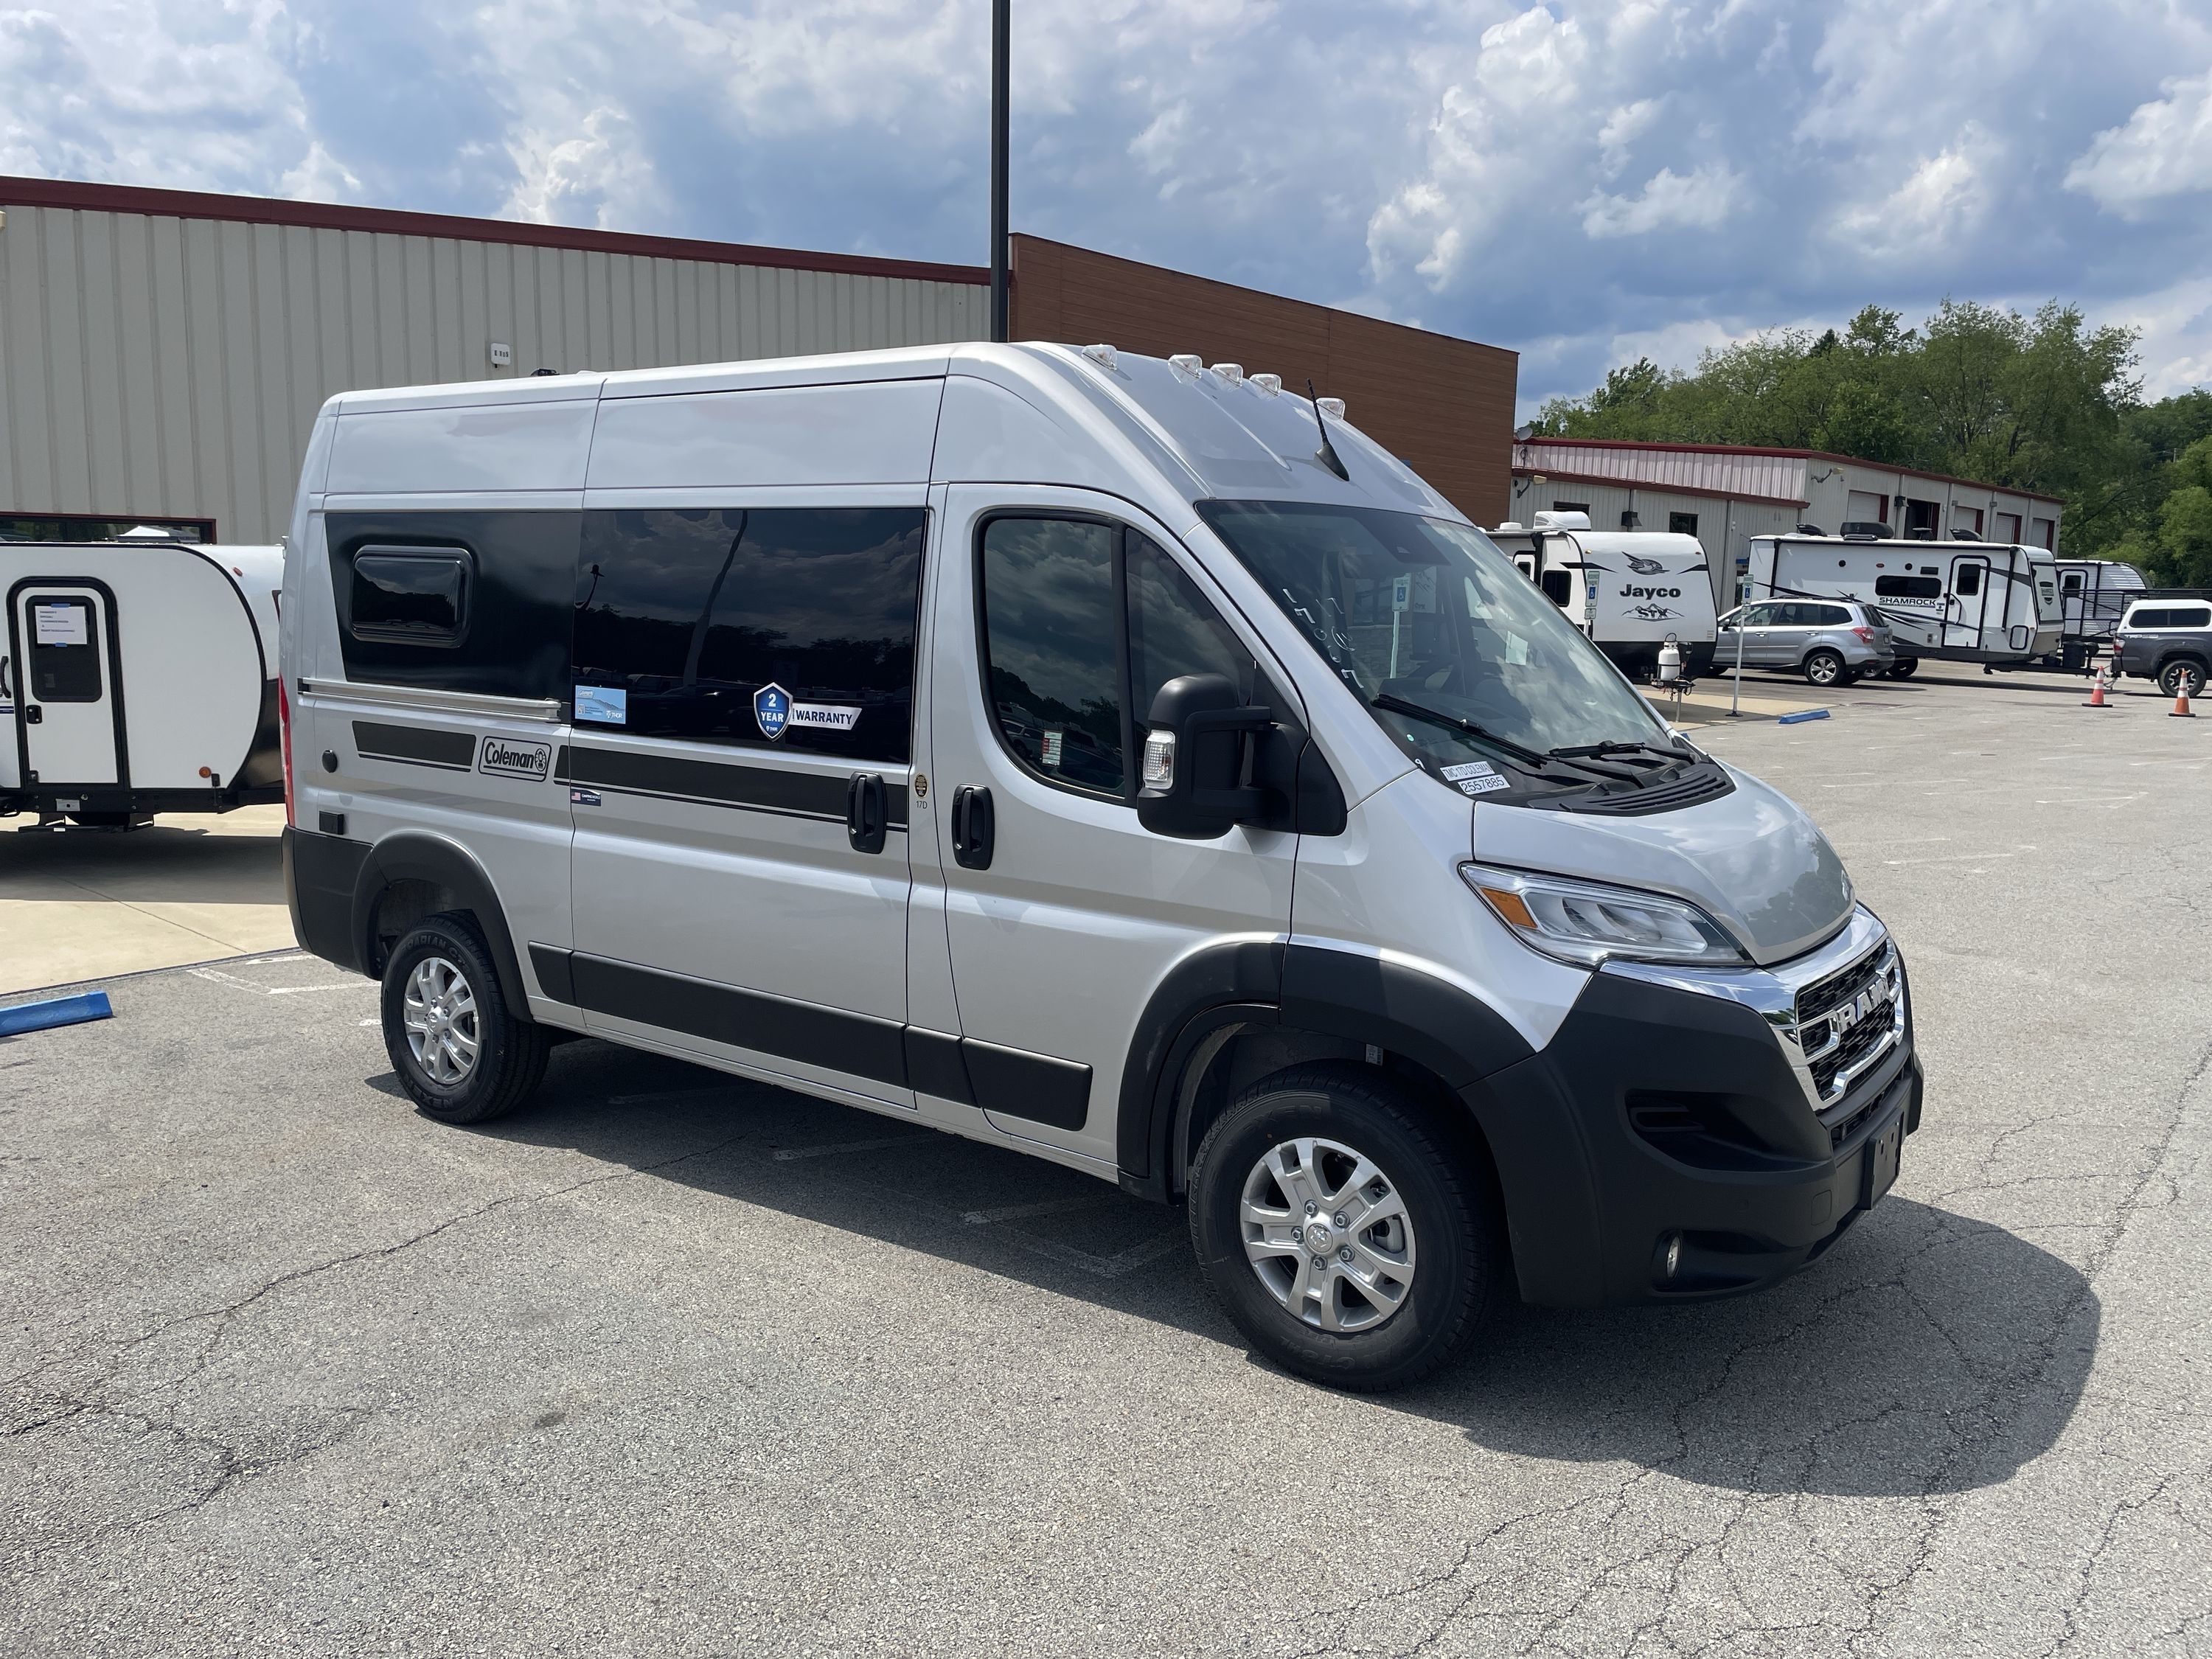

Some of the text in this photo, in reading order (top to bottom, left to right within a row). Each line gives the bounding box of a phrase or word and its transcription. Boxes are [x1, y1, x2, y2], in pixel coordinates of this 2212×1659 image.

[1619, 583, 1681, 600] Jayco
[1879, 597, 1937, 606] SHAMROCK
[1635, 606, 1668, 619] STX
[768, 693, 777, 708] 2
[760, 711, 785, 723] YEAR
[796, 709, 853, 726] WARRANTY
[484, 741, 535, 768] Coleman
[1461, 777, 1505, 792] 2557885
[916, 800, 928, 810] 17D
[1836, 978, 1889, 1034] RAM
